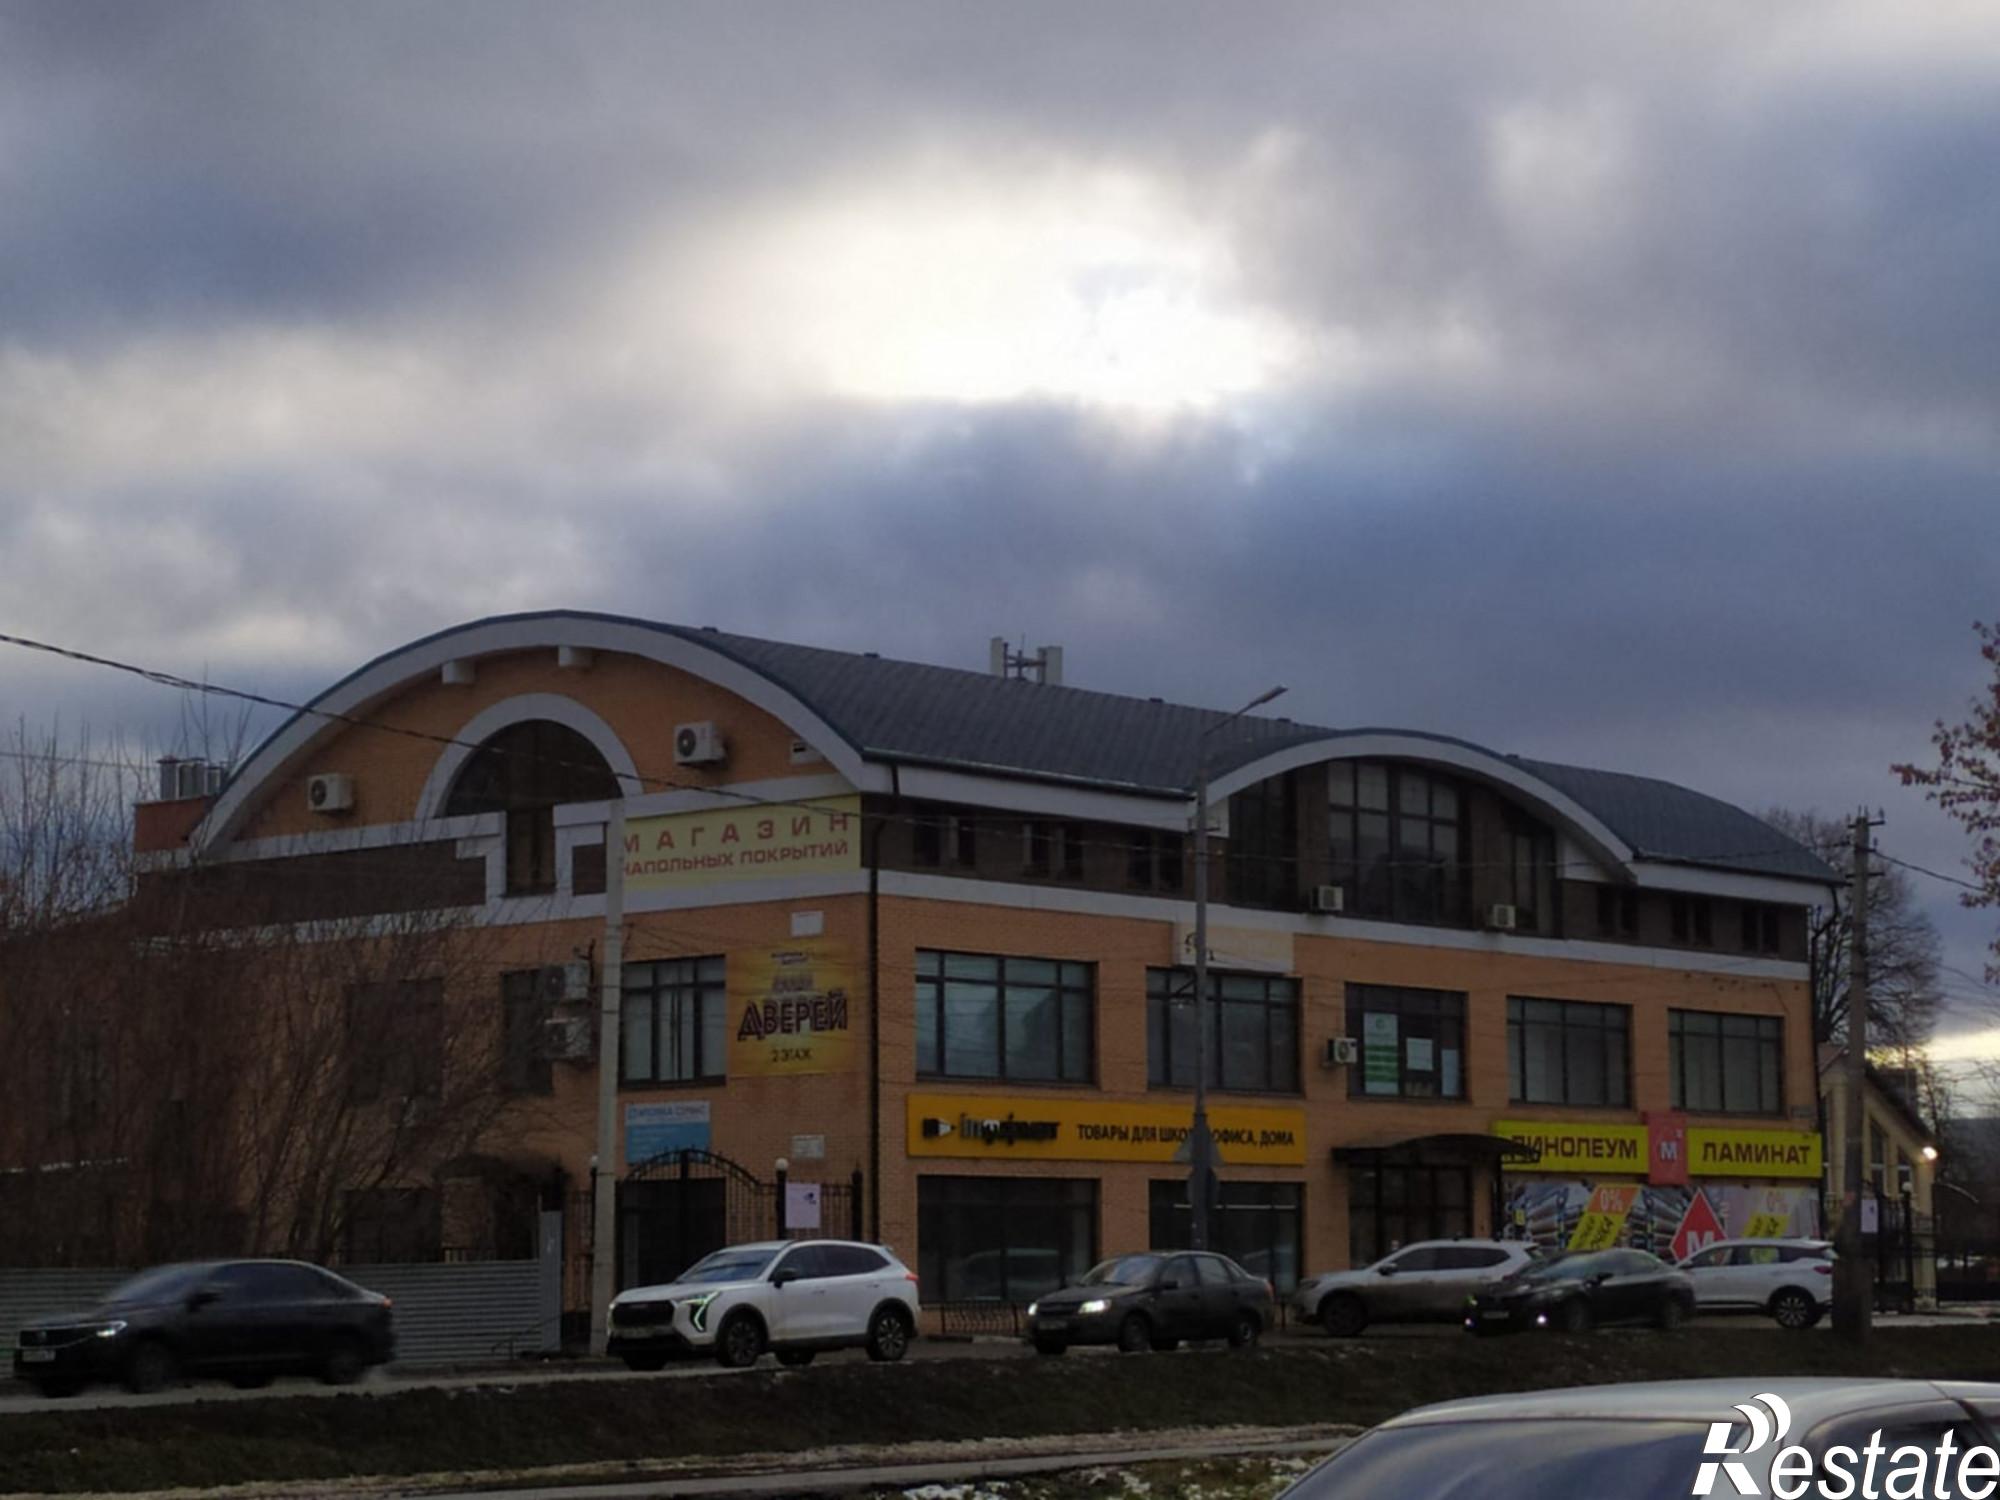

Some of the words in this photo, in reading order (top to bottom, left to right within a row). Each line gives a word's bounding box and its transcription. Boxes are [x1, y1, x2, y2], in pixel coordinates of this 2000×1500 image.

[740, 839, 848, 864] ПОКРЫТИЙ
[737, 988, 848, 1041] ДВЕРЕЙ
[1078, 1124, 1128, 1141] ТОВАРЫ
[1132, 1126, 1156, 1143] ДЛЯ
[1159, 1127, 1191, 1142] ШКО
[1261, 1130, 1295, 1147] ДОМА
[1702, 1142, 1811, 1165] ЛАМИНАТ
